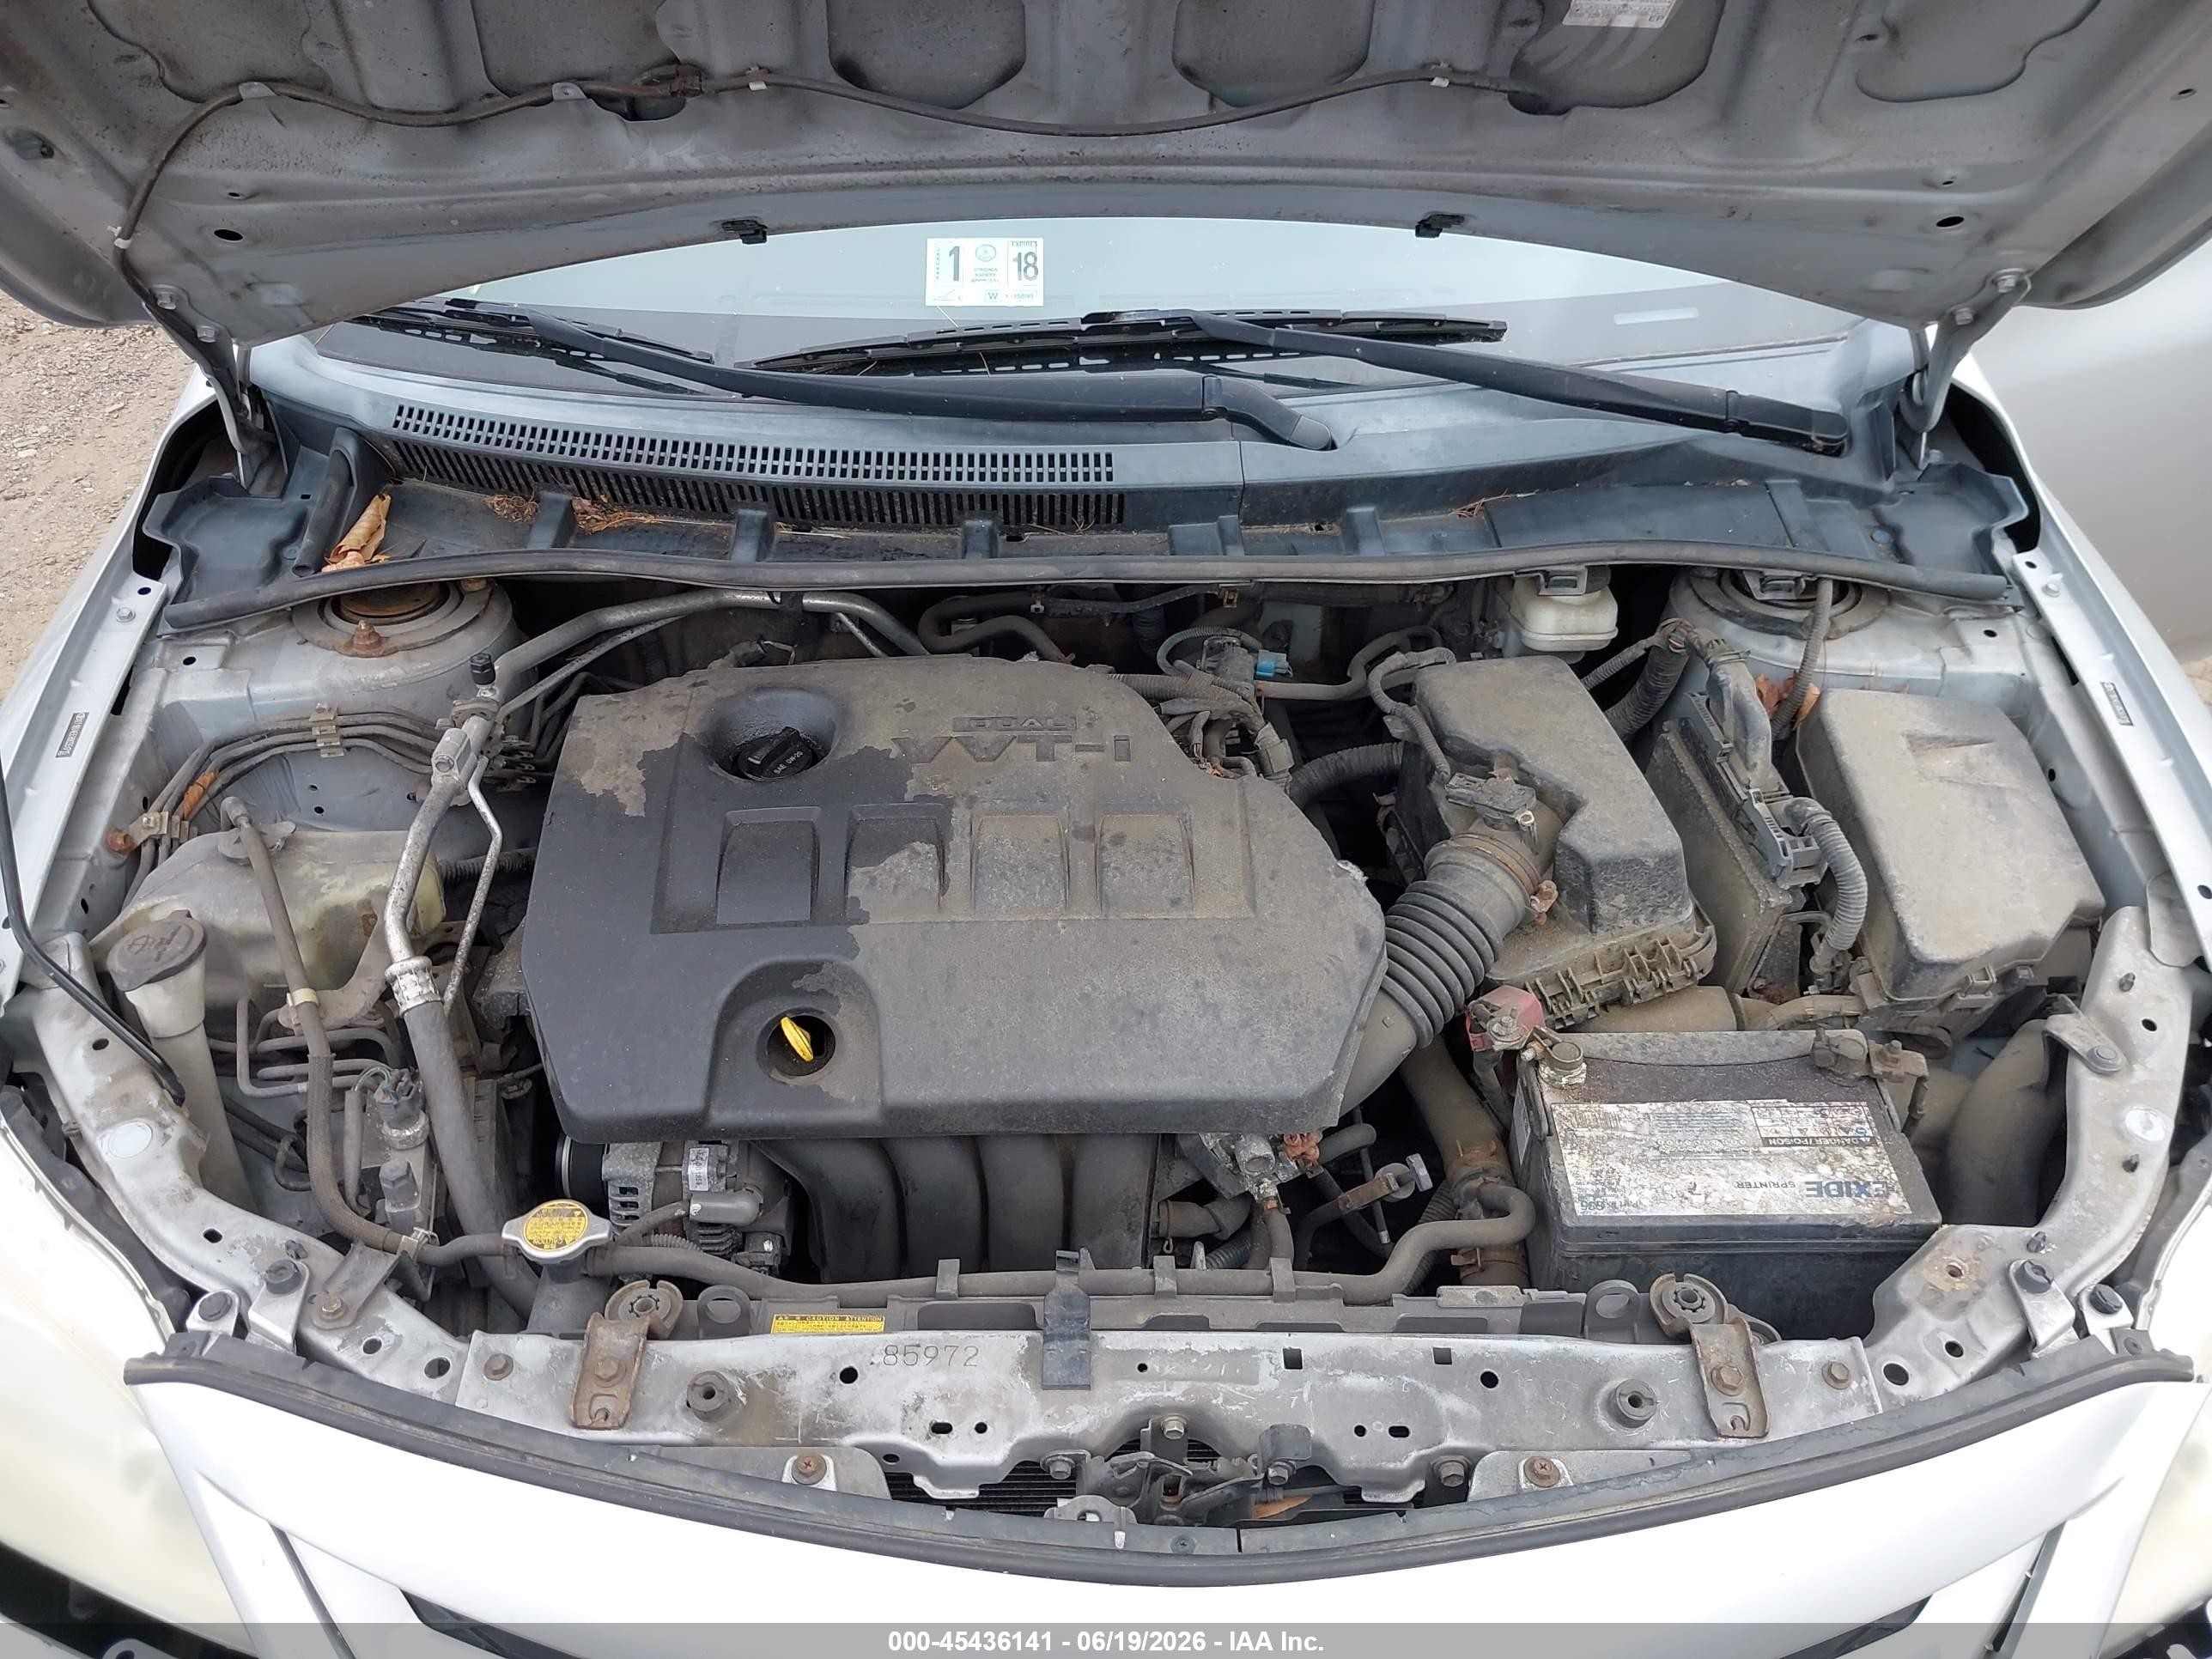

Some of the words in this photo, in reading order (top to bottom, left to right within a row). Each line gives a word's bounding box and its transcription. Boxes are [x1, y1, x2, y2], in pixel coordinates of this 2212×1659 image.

[948, 246, 961, 282] 1
[1012, 251, 1039, 281] 18
[988, 292, 999, 301] W
[773, 763, 787, 775] SAE
[1736, 1181, 1796, 1189] SPRINTER
[1805, 1181, 1889, 1198] EXIDE
[883, 1344, 979, 1367] 85972
